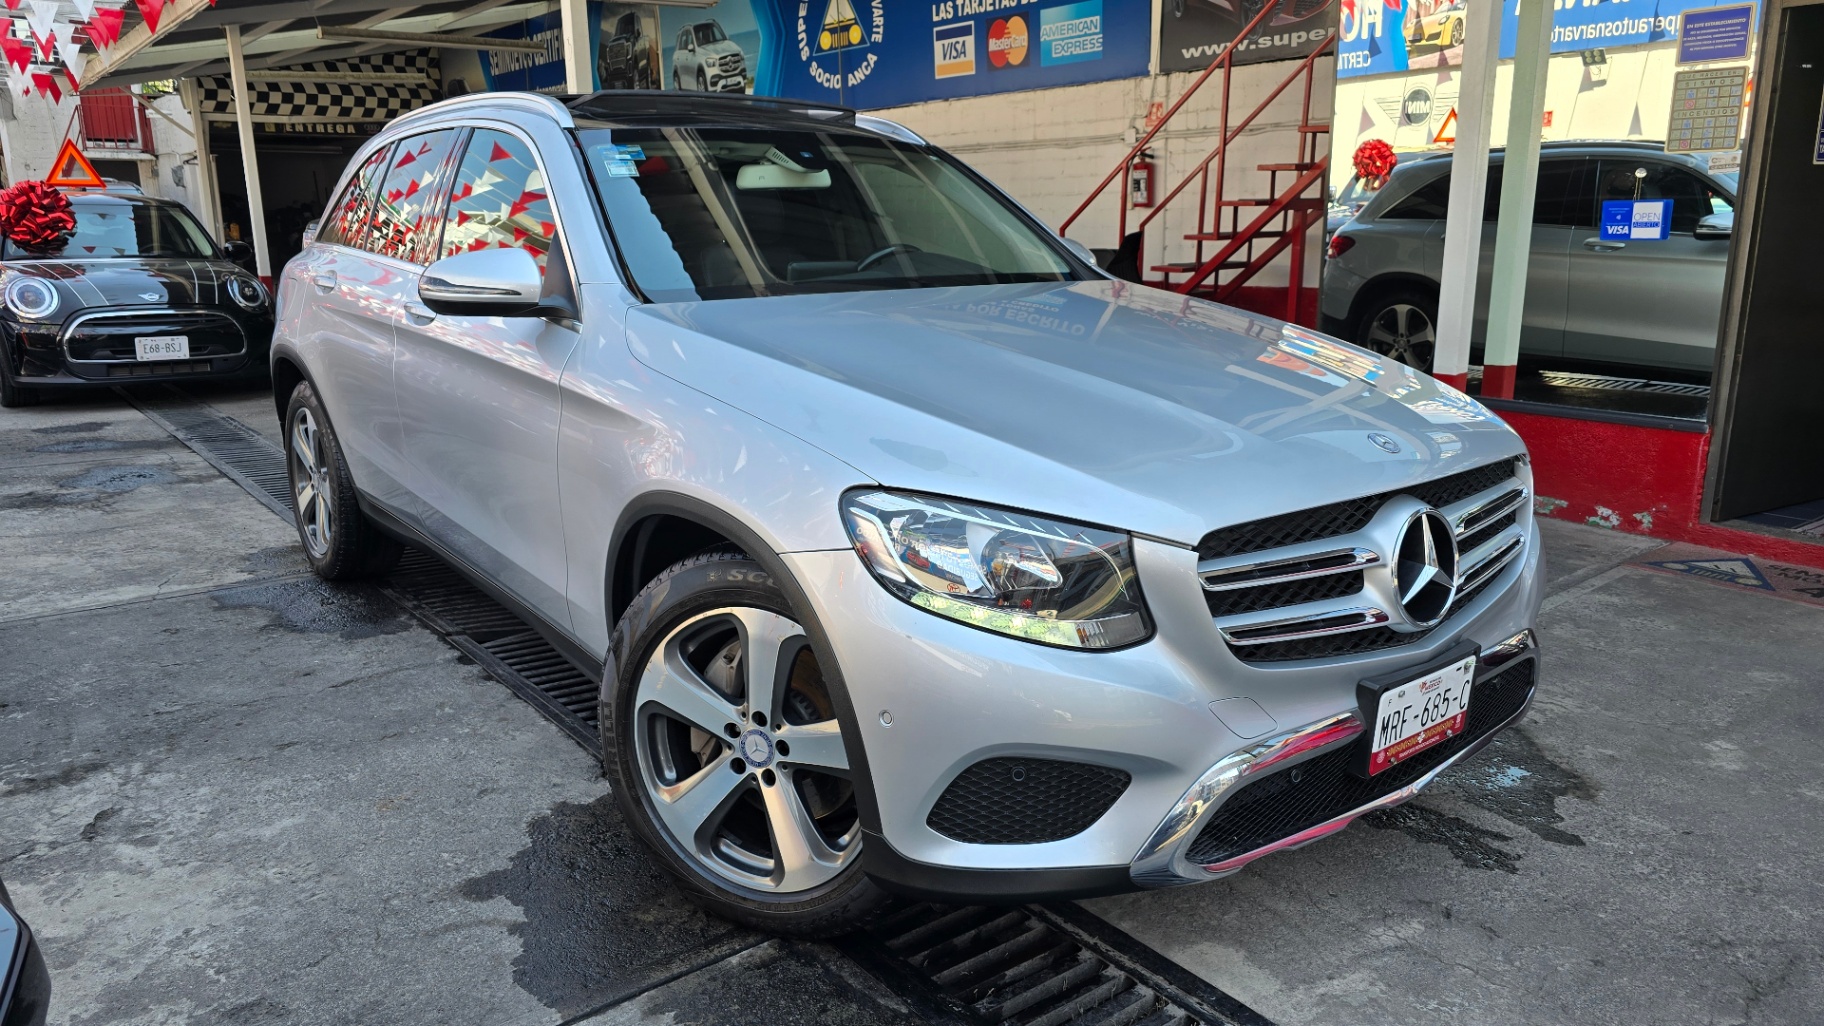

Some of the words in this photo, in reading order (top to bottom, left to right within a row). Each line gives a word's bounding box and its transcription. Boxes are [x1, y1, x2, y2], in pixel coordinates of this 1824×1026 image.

[932, 1, 954, 22] LAS
[1040, 15, 1100, 41] AMERICAN
[941, 39, 967, 61] VISA
[988, 35, 1028, 51] MasterCard
[1053, 34, 1103, 58] EXPRESS
[809, 61, 842, 89] SOCIO
[847, 53, 878, 87] ANCA
[1685, 79, 1735, 87] SISMOS
[1677, 109, 1735, 118] INCENDIOS
[286, 123, 356, 134] ENTREGA
[1634, 212, 1660, 221] OPEN
[1606, 226, 1629, 234] VISA
[143, 342, 182, 354] E68-BSJ
[1378, 679, 1470, 749] MRF-685-C
